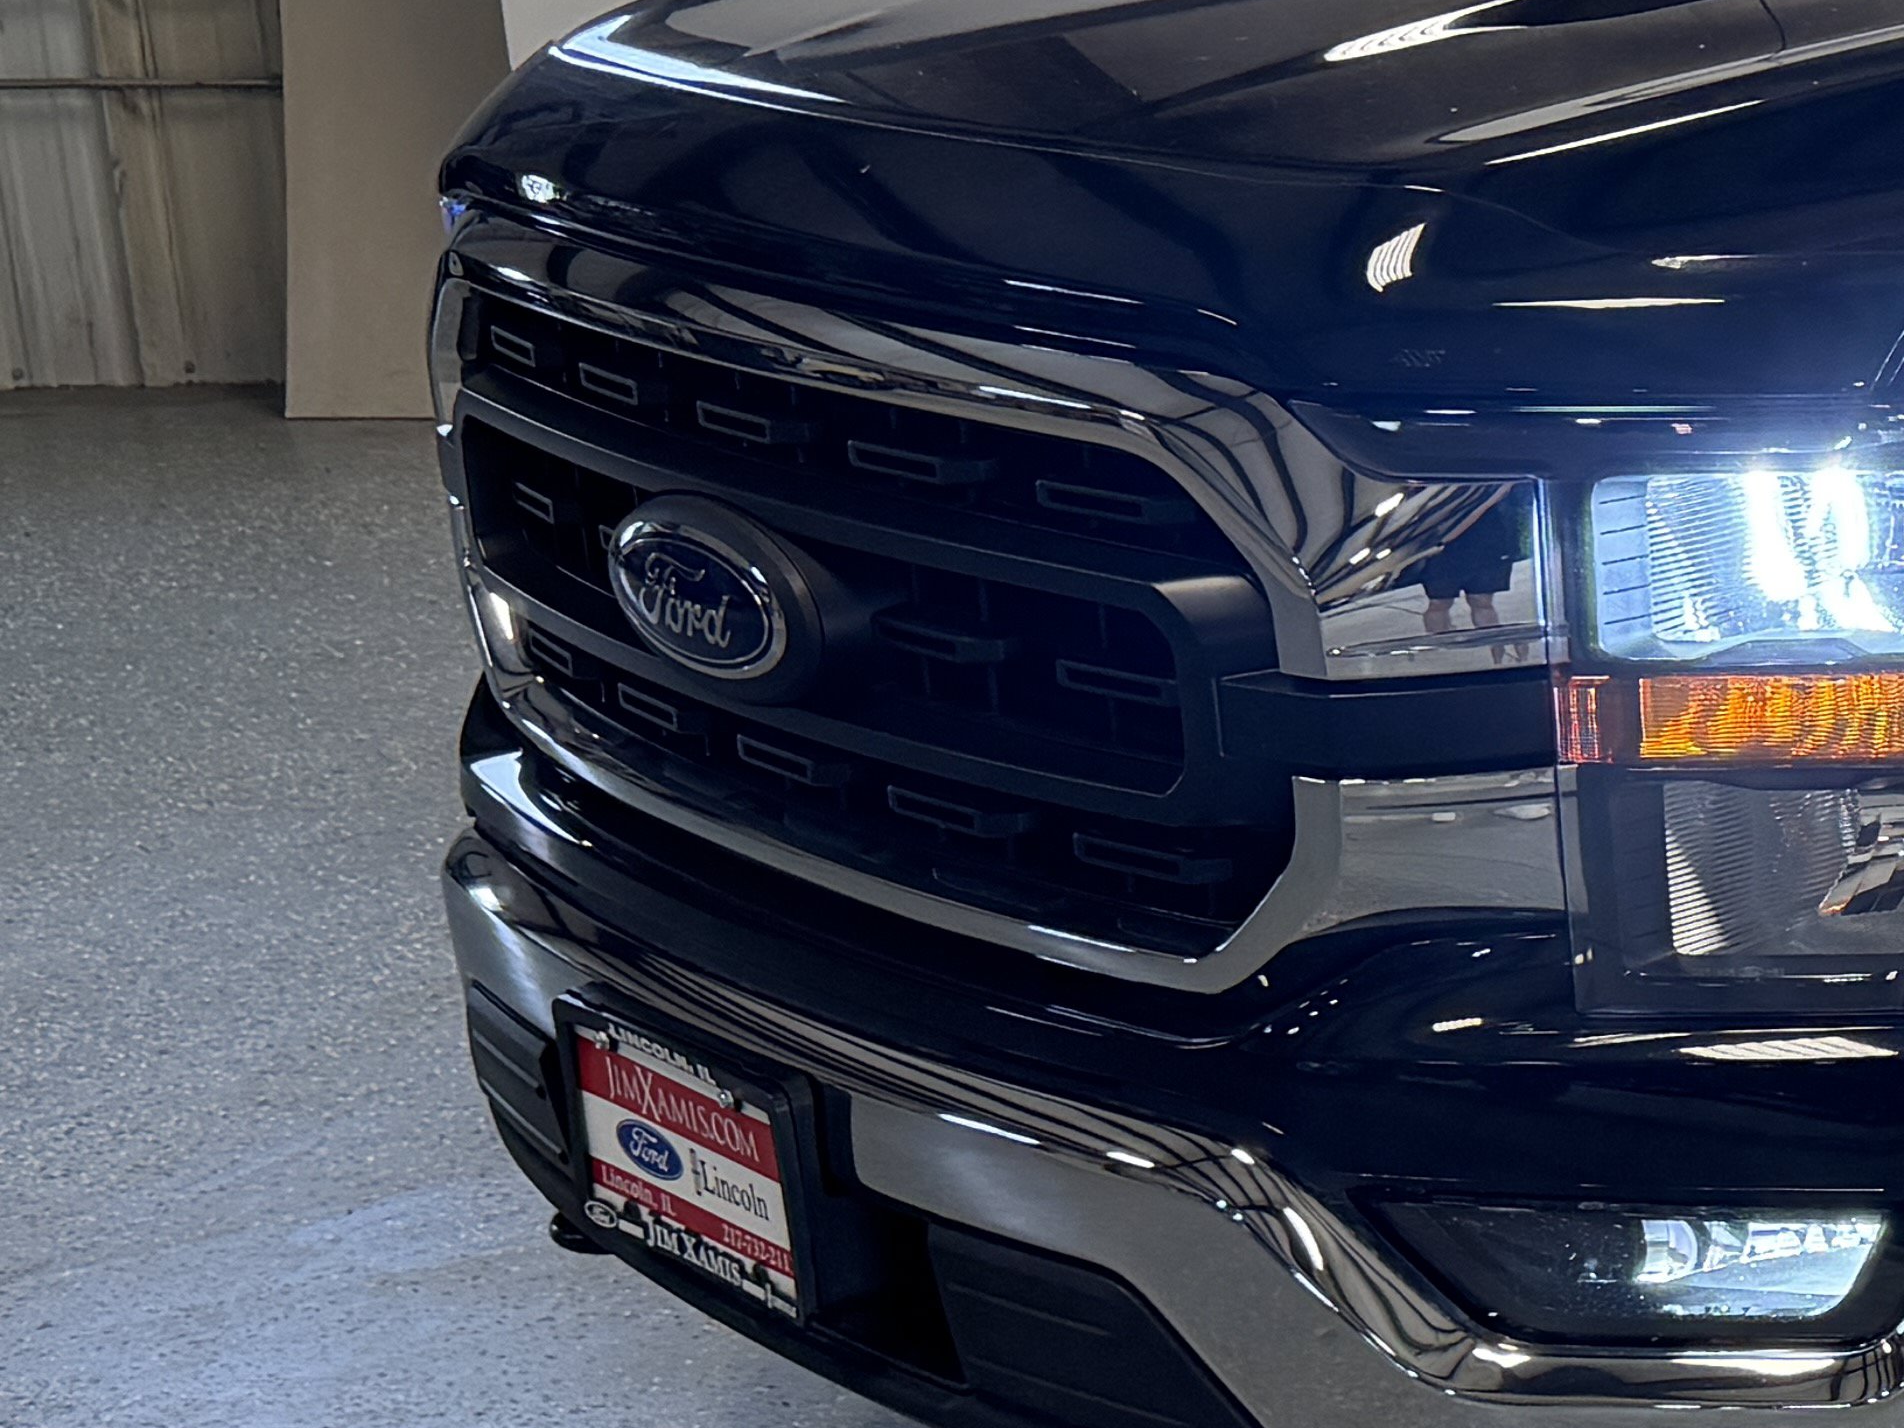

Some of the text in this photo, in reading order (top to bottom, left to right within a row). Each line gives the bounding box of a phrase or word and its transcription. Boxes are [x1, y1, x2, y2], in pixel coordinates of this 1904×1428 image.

[638, 551, 732, 649] Ford
[629, 1127, 670, 1173] Ford
[698, 1159, 770, 1221] Lincoln
